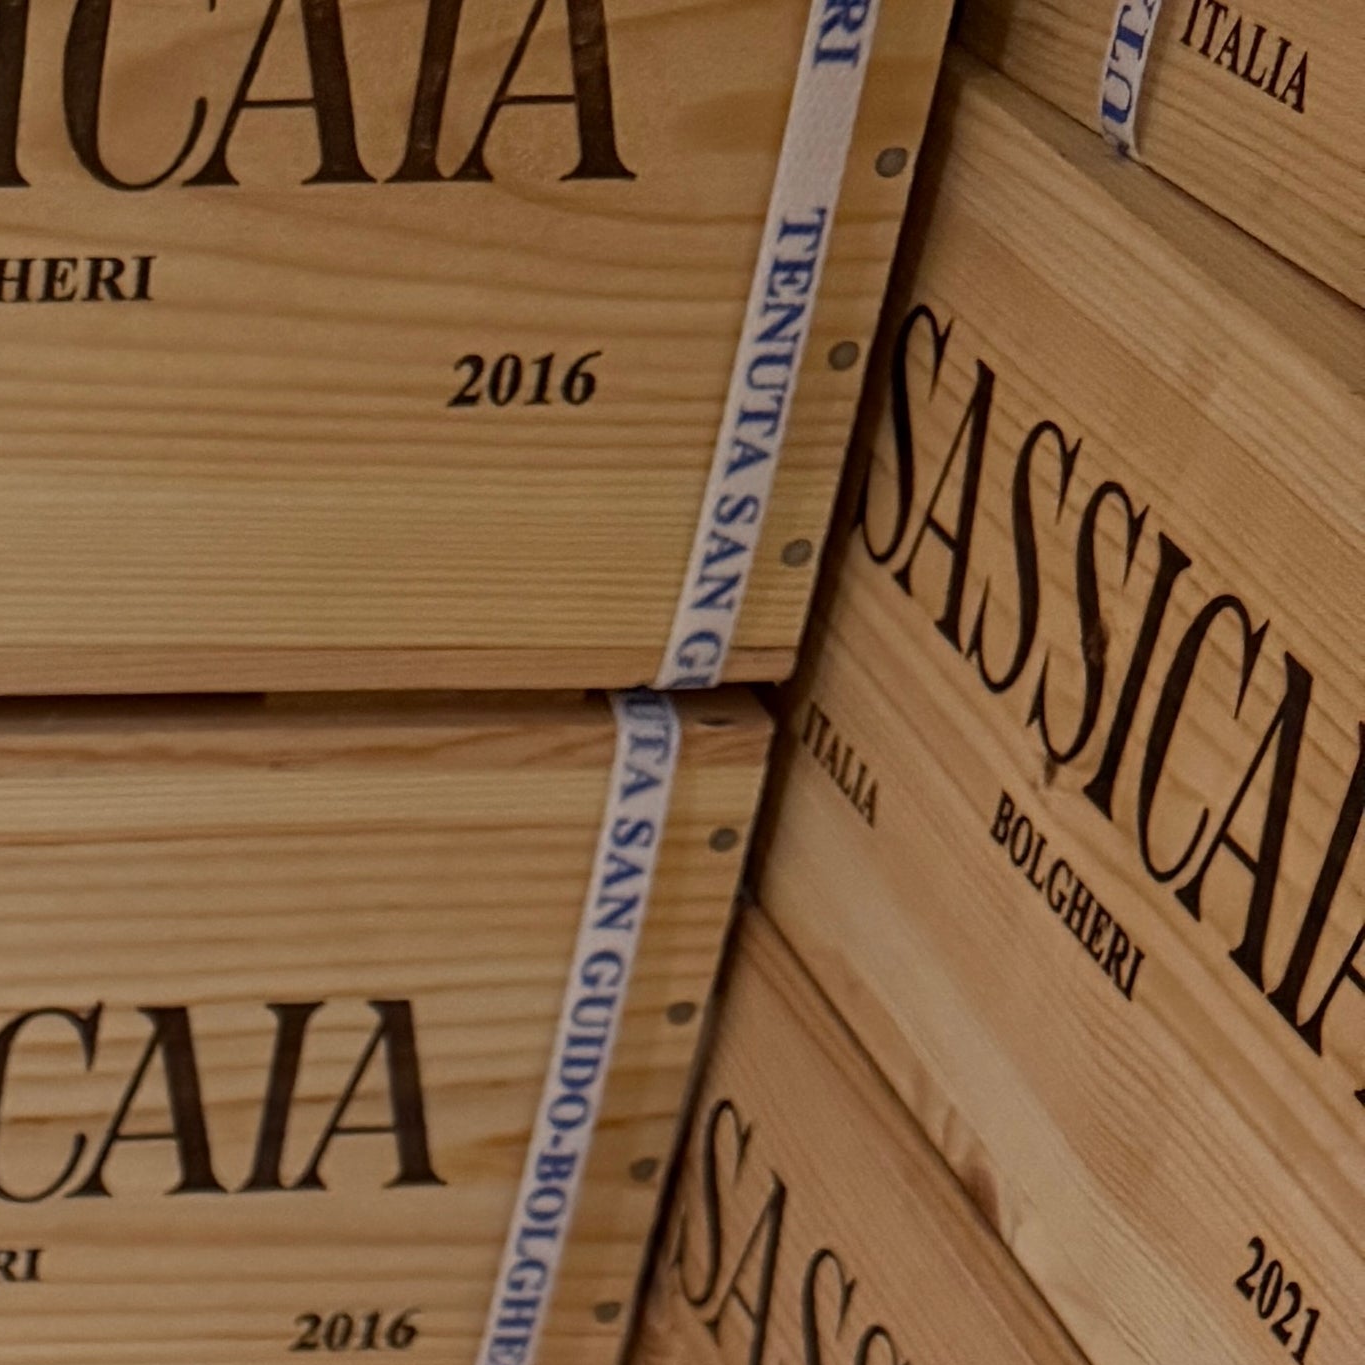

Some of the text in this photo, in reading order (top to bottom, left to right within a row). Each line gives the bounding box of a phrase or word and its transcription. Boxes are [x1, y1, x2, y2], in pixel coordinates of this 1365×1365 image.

[1181, 0, 1308, 114] ITALIA
[447, 350, 604, 408] 2016
[725, 207, 827, 478] TENUTA
[693, 493, 760, 612] SAN
[802, 702, 878, 828] ITALIA
[594, 818, 655, 934] SAN
[991, 790, 1146, 1000] BOLGHERI
[289, 1310, 421, 1351] 2016
